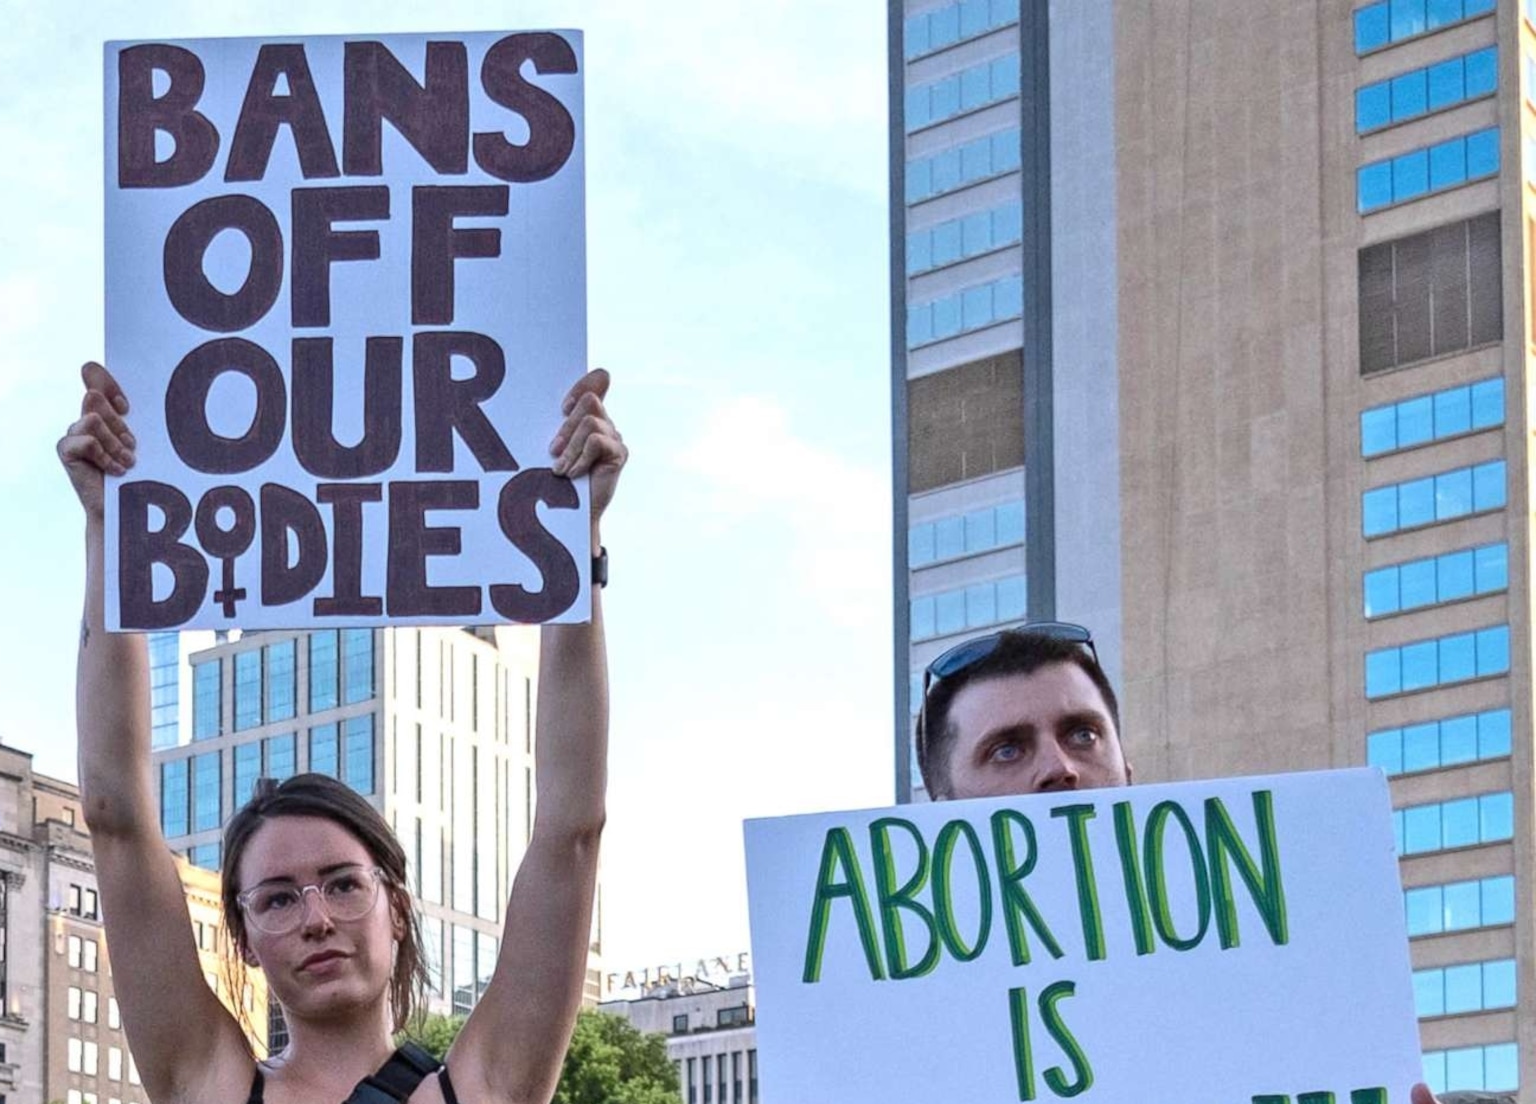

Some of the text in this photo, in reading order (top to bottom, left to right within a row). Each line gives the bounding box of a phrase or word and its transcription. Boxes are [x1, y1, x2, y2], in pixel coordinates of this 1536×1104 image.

[118, 32, 579, 189] BANS
[163, 185, 510, 332] OFF
[165, 331, 519, 479] OUR
[118, 468, 581, 630] BODIES
[802, 789, 1290, 983] ABORTION
[1009, 980, 1094, 1103] IS
